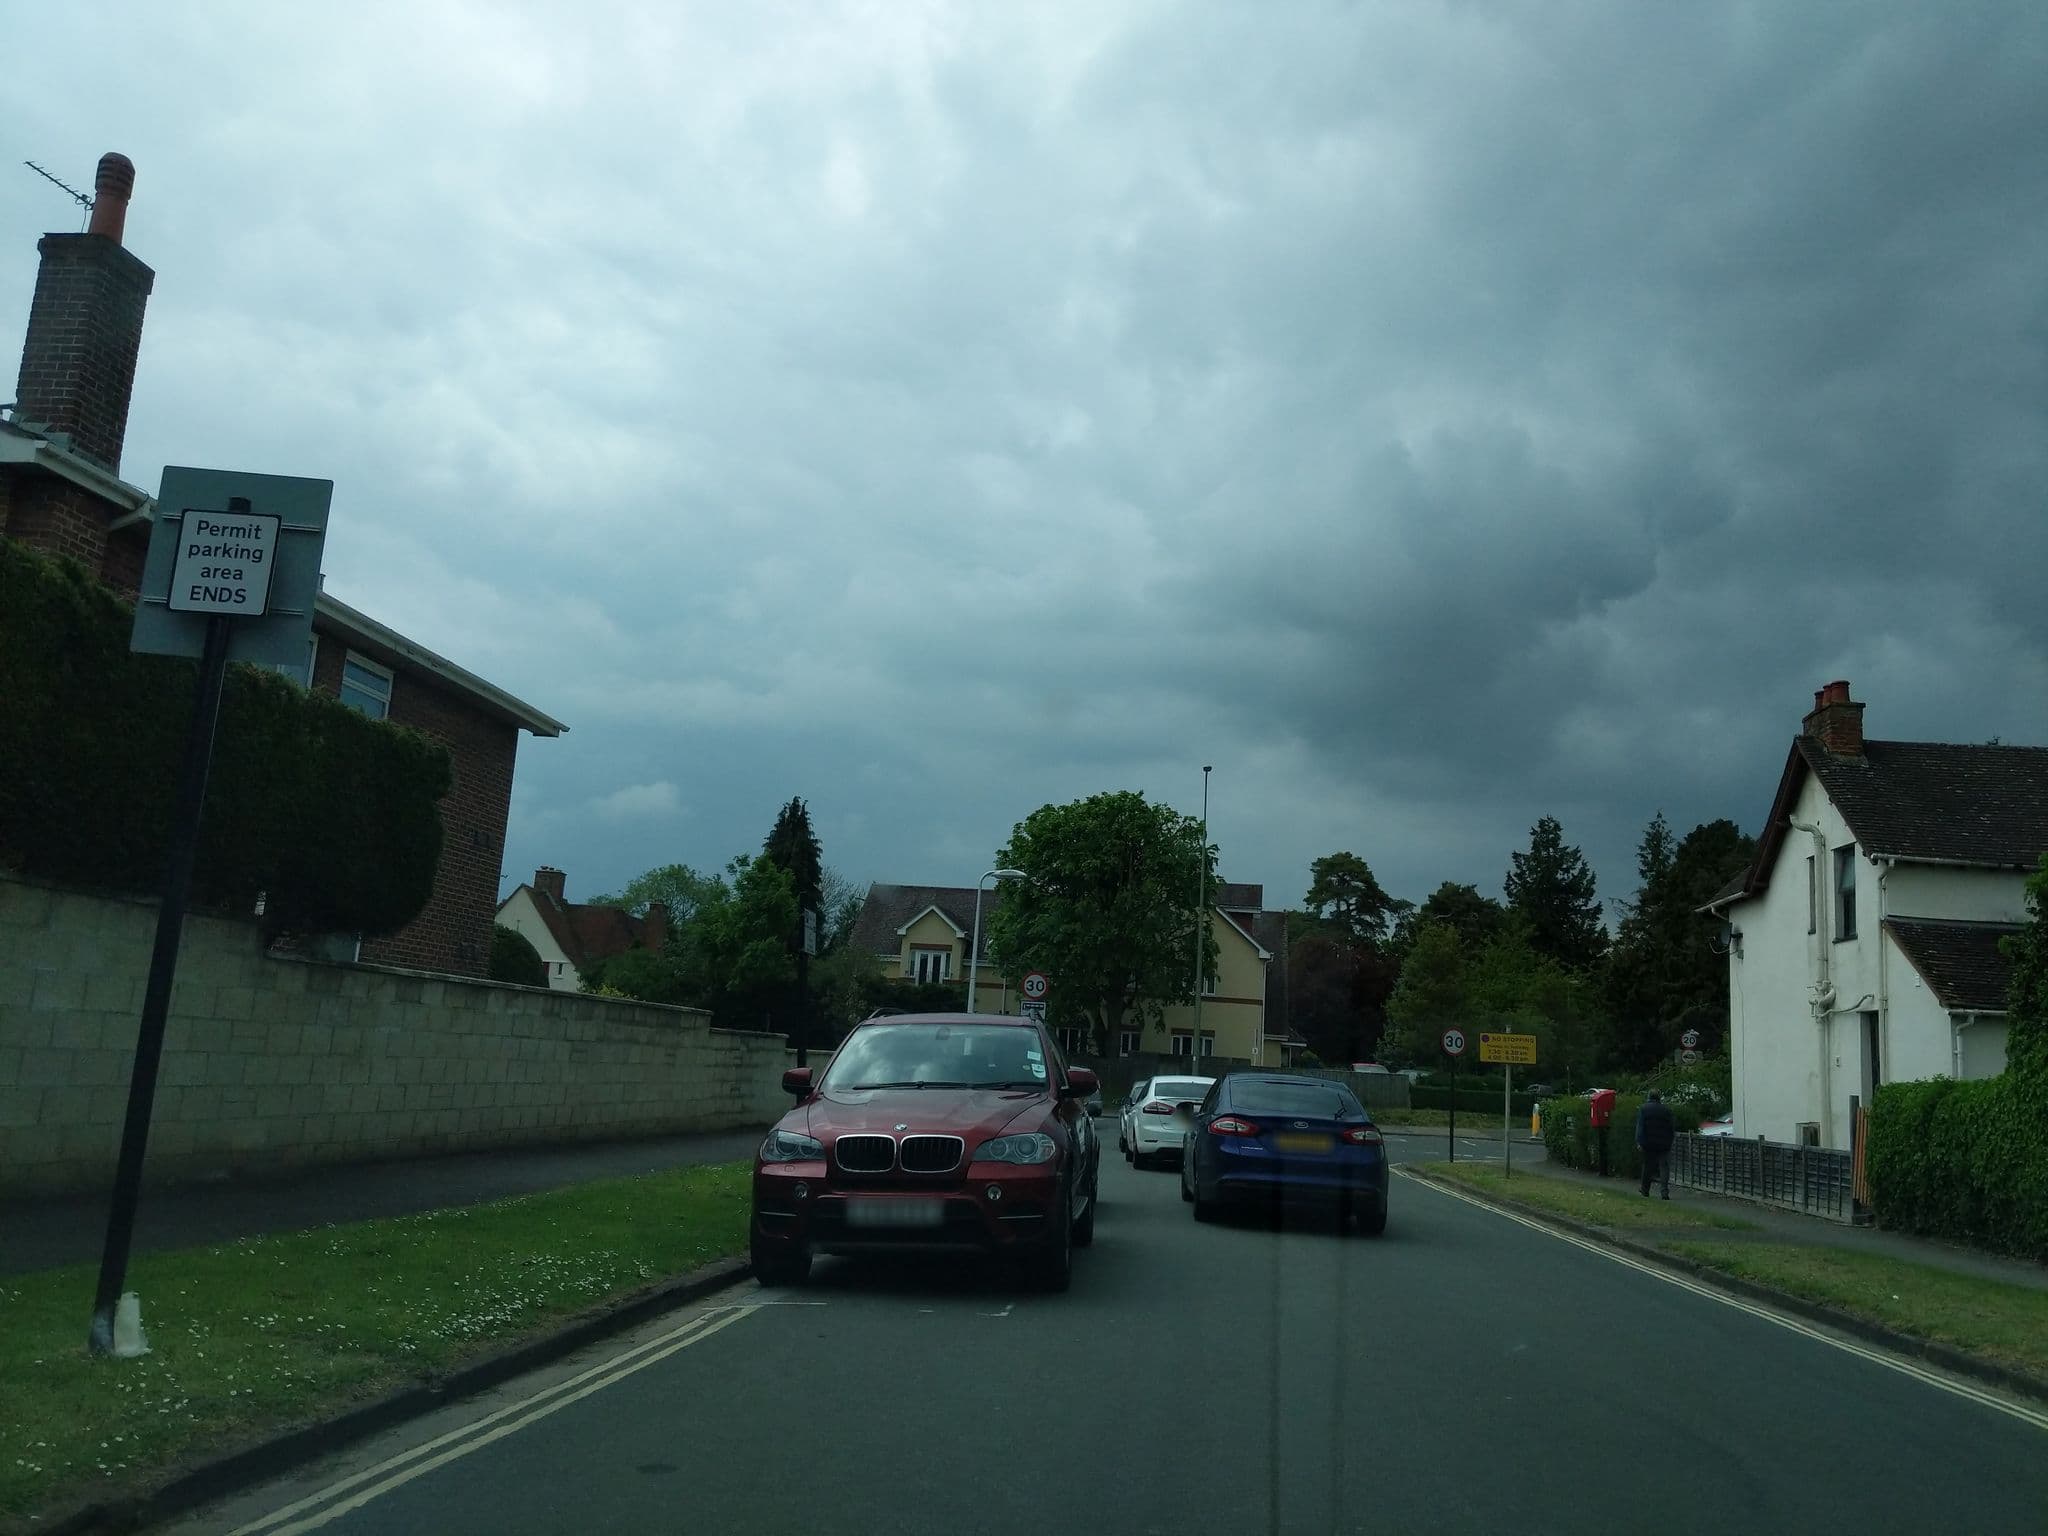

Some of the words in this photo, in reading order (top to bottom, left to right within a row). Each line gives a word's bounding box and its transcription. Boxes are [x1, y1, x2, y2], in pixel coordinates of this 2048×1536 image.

[196, 520, 262, 539] Permit
[188, 542, 264, 563] parking
[200, 566, 243, 580] area
[189, 585, 247, 604] ENDS
[1026, 980, 1045, 992] 30
[1445, 1036, 1463, 1048] 30
[1503, 1036, 1534, 1044] STOPPING
[1683, 1036, 1695, 1044] 20
